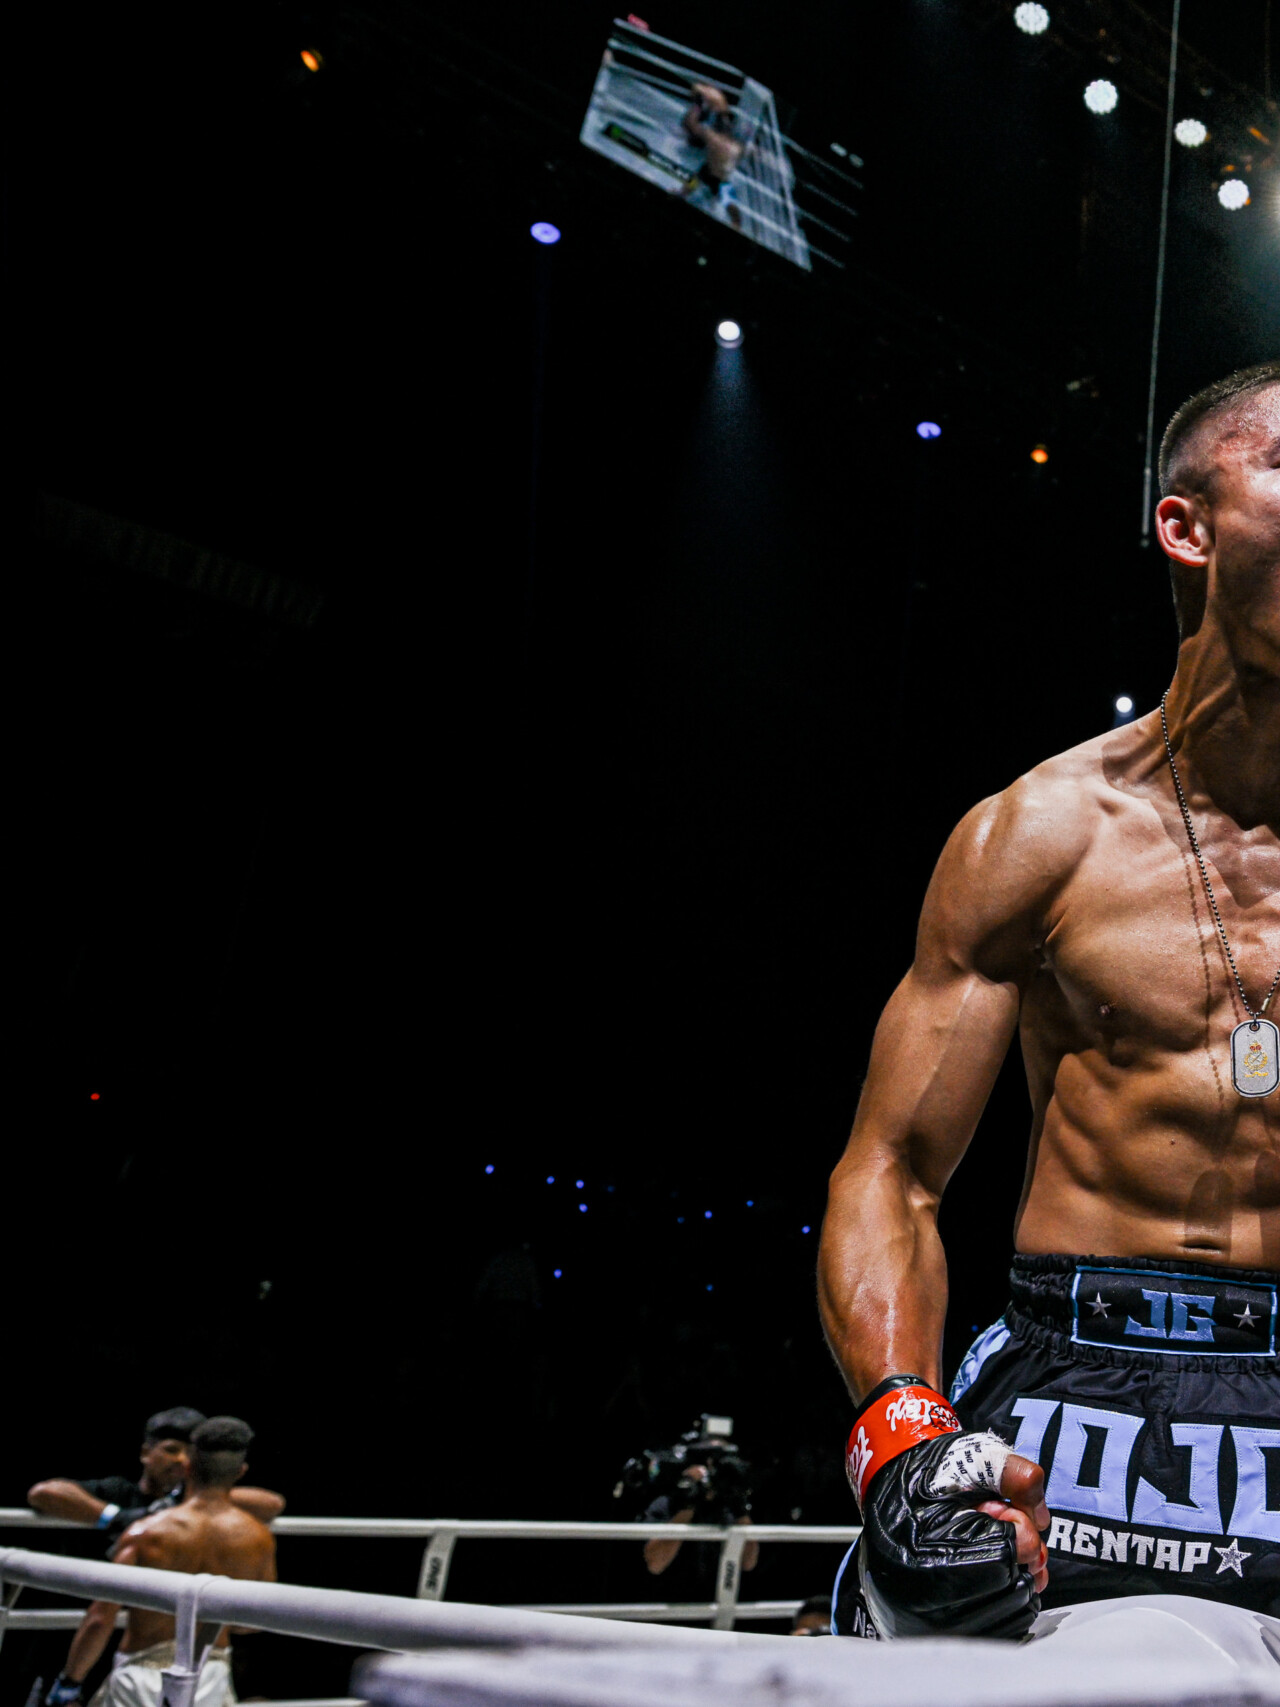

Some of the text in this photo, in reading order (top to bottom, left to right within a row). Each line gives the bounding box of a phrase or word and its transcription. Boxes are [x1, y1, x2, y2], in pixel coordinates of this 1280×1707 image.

[964, 1450, 974, 1463] ONE
[956, 1460, 968, 1475] ONE
[985, 1461, 994, 1478] ONE
[1047, 1516, 1212, 1573] RENTAP
